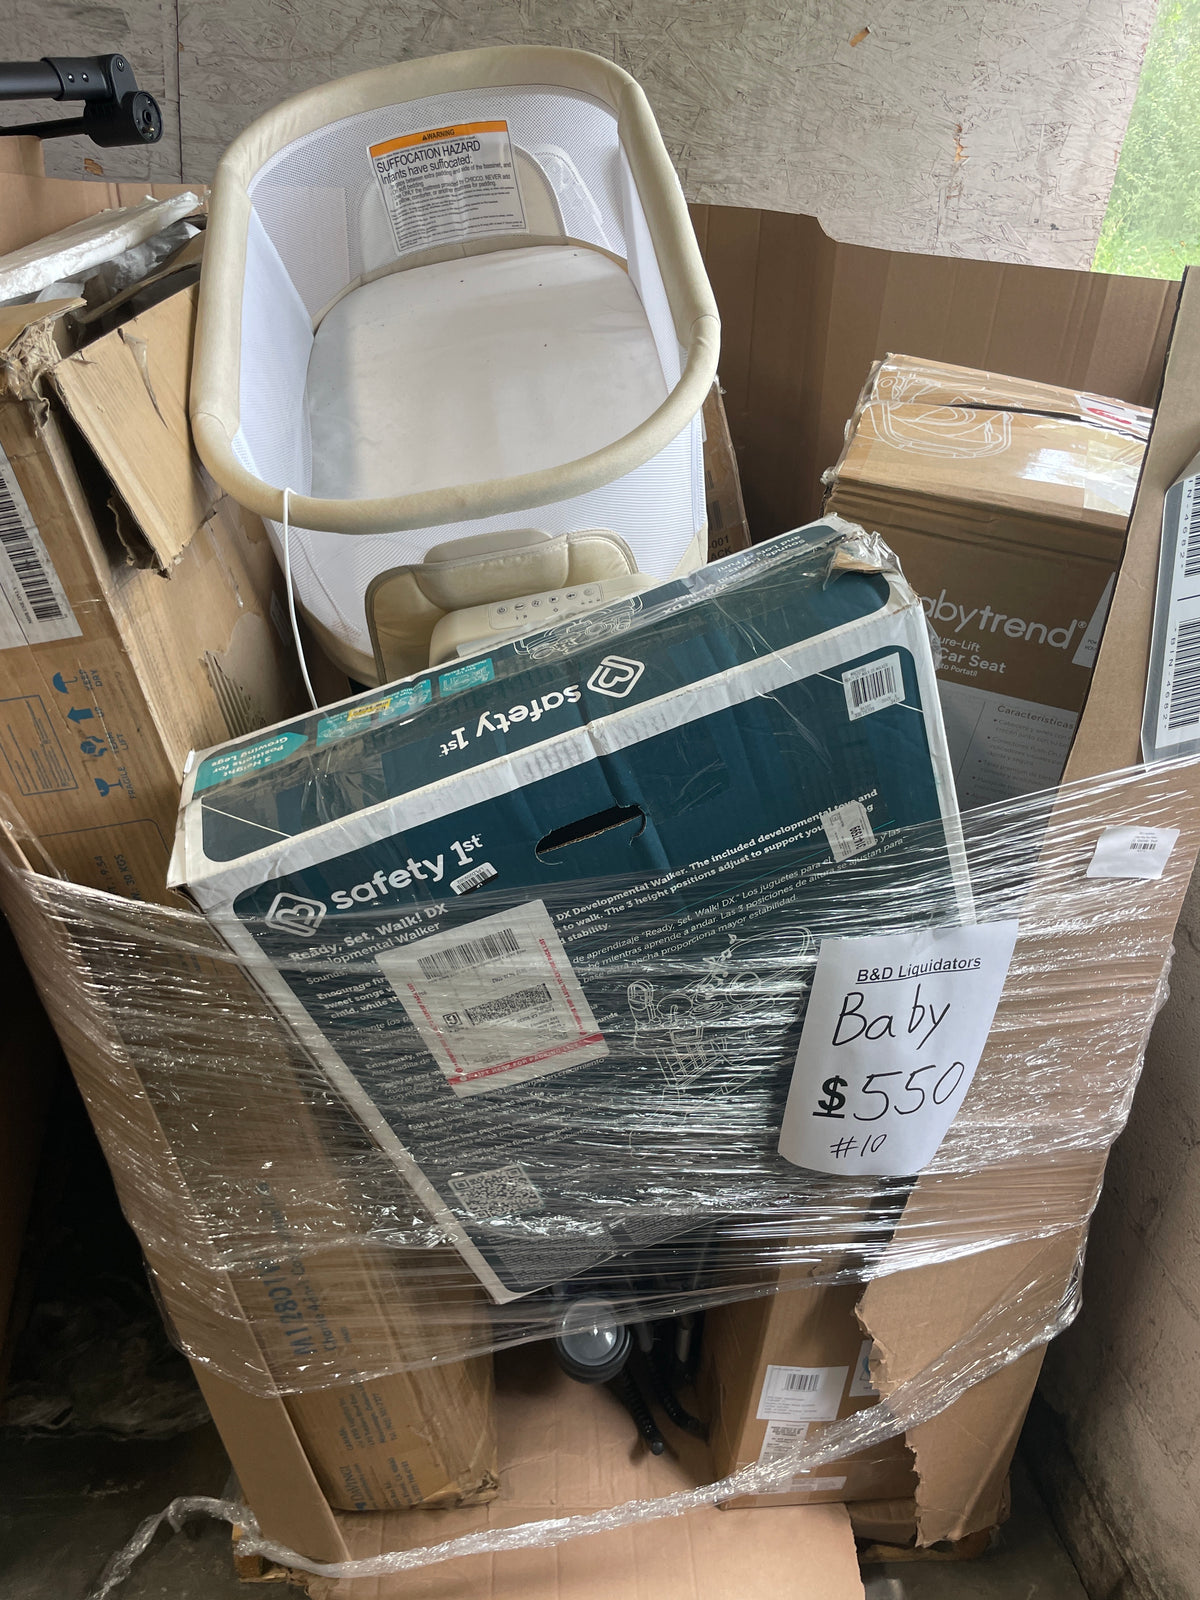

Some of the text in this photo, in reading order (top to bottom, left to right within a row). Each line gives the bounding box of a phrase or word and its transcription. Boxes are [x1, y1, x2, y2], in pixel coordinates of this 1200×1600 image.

[427, 129, 453, 139] WARNING
[377, 148, 439, 171] SUFFOCATION
[442, 141, 480, 156] HAZARD
[381, 154, 471, 183] Infants have suffocated:
[484, 172, 501, 180] NEVER
[764, 538, 804, 557] Sounds,
[939, 638, 979, 651] ure-Lift
[939, 647, 964, 662] Car
[969, 654, 1005, 673] Seat
[89, 669, 103, 686] DRY
[93, 706, 105, 717] UP
[476, 685, 581, 737] safety
[115, 733, 129, 750] LIFT
[211, 736, 287, 766] Growing Legs
[440, 727, 468, 755] 1st
[211, 745, 283, 772] Positions for
[222, 760, 261, 776] Height
[117, 767, 137, 798] FRAGILE
[555, 910, 572, 920] DX
[572, 883, 649, 914] Developmental
[650, 866, 687, 887] Walker.
[688, 858, 710, 869] The
[710, 838, 756, 860] included
[757, 809, 832, 843] developmental
[856, 788, 878, 801] and
[331, 854, 443, 909] safety
[450, 835, 483, 865] 1st
[575, 912, 602, 926] walk.
[603, 904, 625, 915] The
[634, 888, 669, 905] height
[669, 869, 715, 892] positions
[717, 851, 753, 873] adjust
[750, 849, 762, 857] to
[763, 832, 803, 854] support
[571, 954, 585, 963] de
[586, 935, 639, 959] aprendizaje
[695, 902, 719, 917] Walk!
[740, 886, 758, 898] Los
[757, 868, 800, 893] juguetes
[799, 860, 823, 876] para
[601, 944, 641, 964] mientras
[643, 930, 681, 951] aprende
[690, 915, 718, 931] andar.
[719, 908, 736, 919] Las
[744, 883, 793, 909] posiciones
[882, 837, 904, 851] para
[288, 903, 448, 962] Ready, Set, Walk! DX
[395, 922, 440, 944] Walker
[567, 921, 611, 941] stability.
[660, 929, 715, 954] proporciona
[718, 915, 748, 934] mayor
[748, 893, 798, 918] estabilidad.
[857, 958, 980, 981] B&D Liquidators
[317, 980, 370, 1001] Encourage
[324, 988, 384, 1010] sweet songs
[360, 998, 387, 1011] while
[832, 983, 950, 1050] Baby
[830, 1134, 887, 1158] #10
